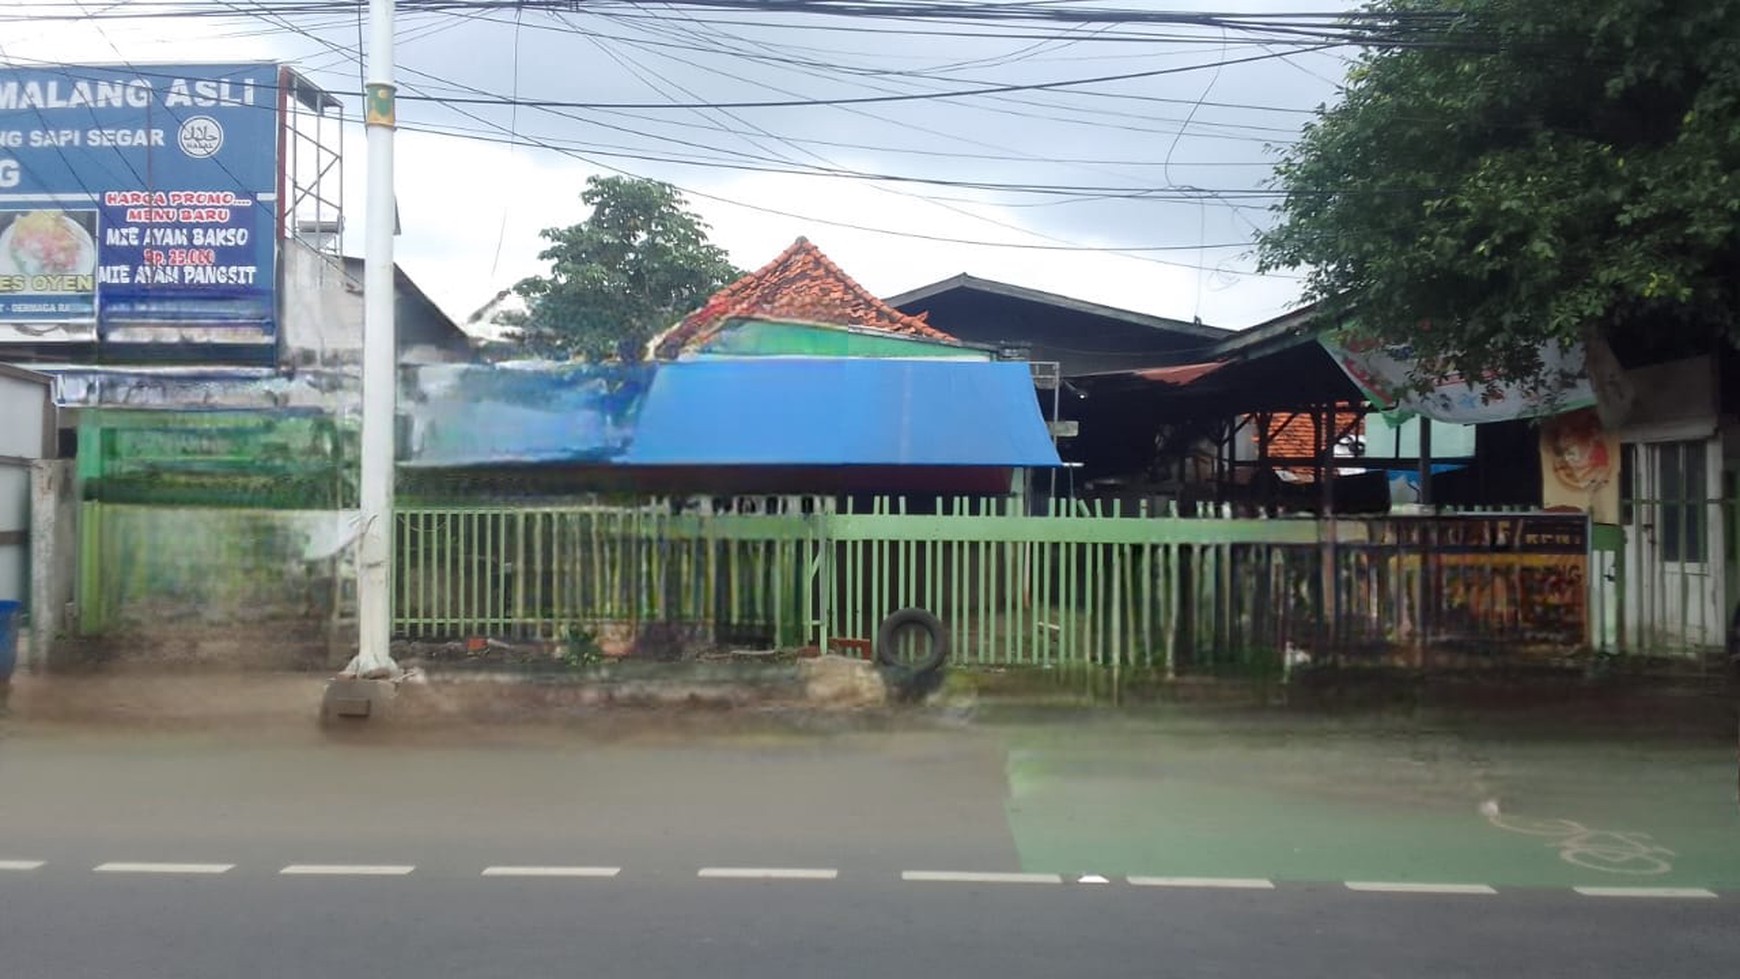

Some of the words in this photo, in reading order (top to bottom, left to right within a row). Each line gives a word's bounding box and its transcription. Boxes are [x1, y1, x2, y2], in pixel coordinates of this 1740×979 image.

[0, 79, 152, 109] MALANG
[165, 78, 255, 108] ASLI
[29, 130, 80, 147] SAPI
[87, 129, 165, 147] SEGAR
[105, 191, 166, 206] HARGA
[126, 208, 176, 222] MENU
[178, 208, 230, 222] BARU
[106, 227, 139, 246] MIE
[143, 228, 188, 246] AYAM
[192, 227, 249, 246] BAKSO
[0, 274, 24, 292] ES
[32, 274, 94, 292] OYEN
[99, 265, 130, 284] MIE
[134, 265, 179, 284] AYAM
[183, 266, 257, 284] PANGSIT
